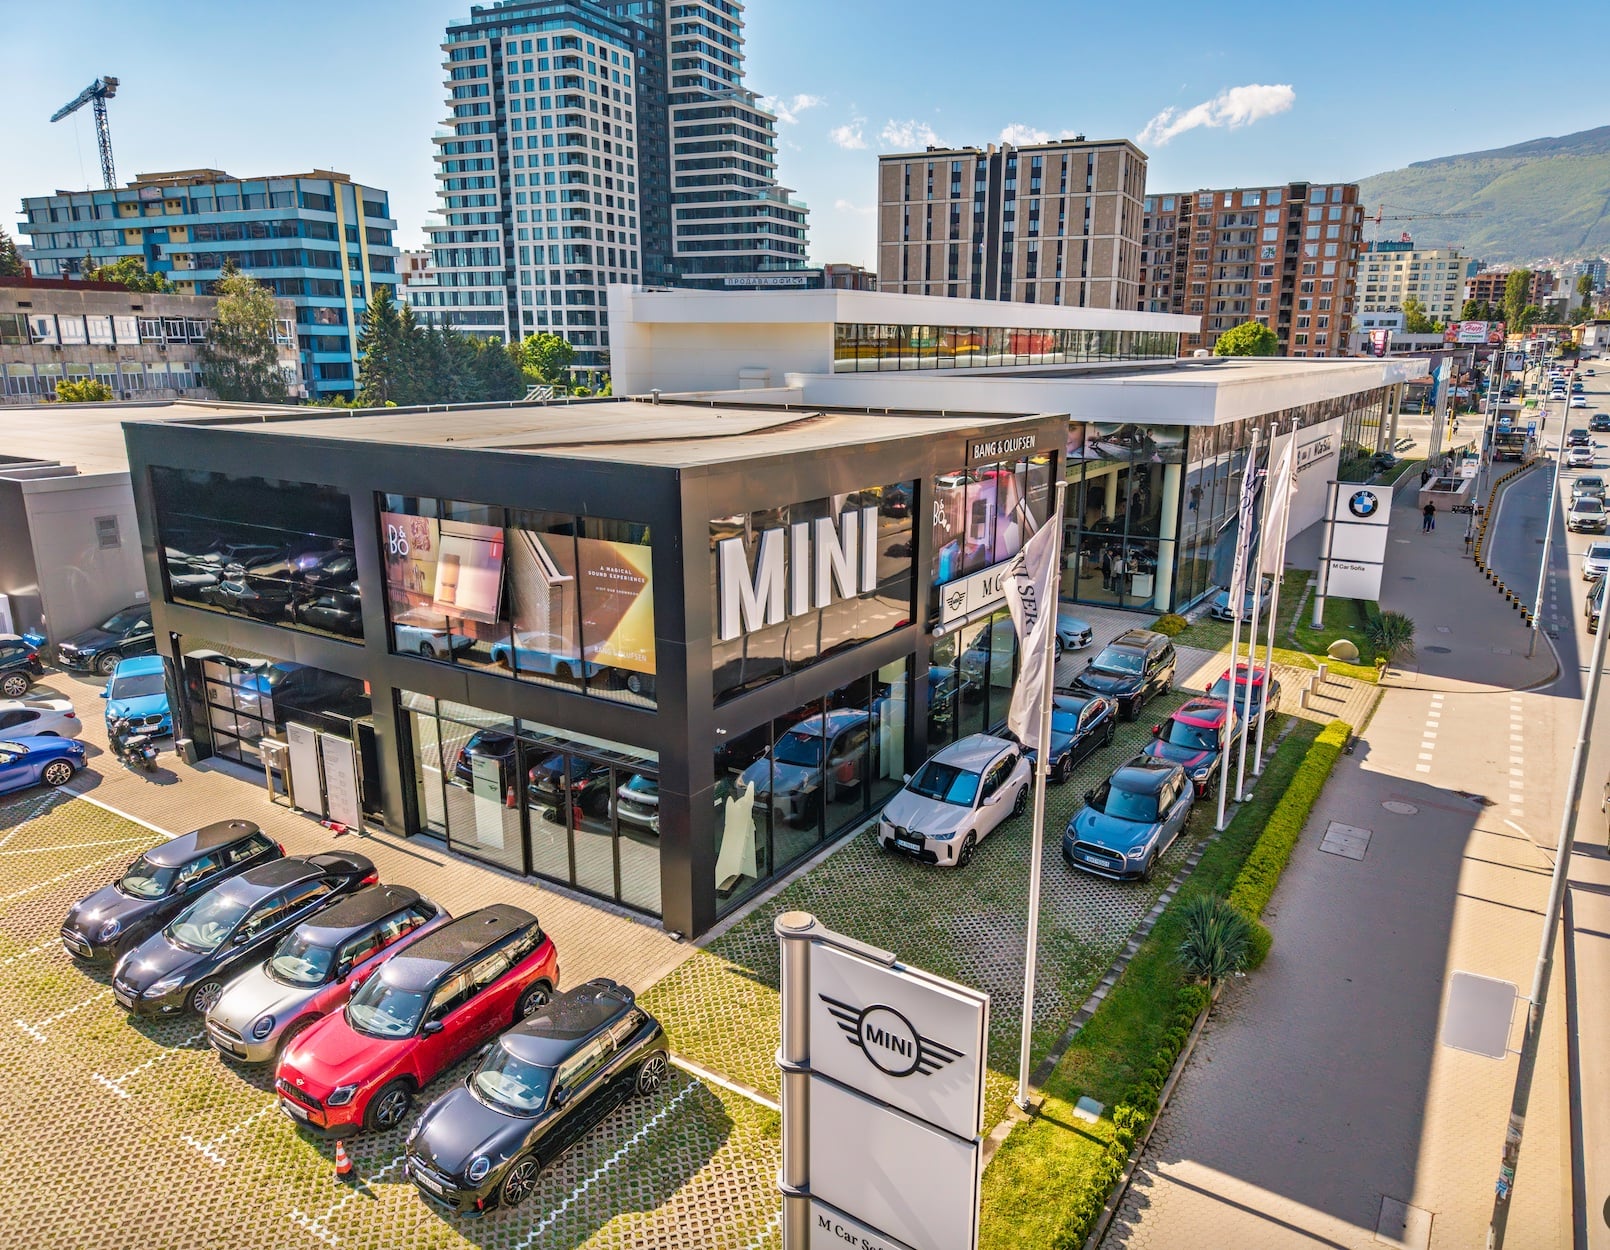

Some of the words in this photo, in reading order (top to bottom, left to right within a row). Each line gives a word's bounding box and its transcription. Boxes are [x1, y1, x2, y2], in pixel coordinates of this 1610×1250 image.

[974, 441, 996, 458] BANG
[997, 440, 1003, 454] &
[1003, 435, 1036, 453] OLUFSEN
[588, 570, 607, 578] SOUND
[609, 573, 645, 583] EXPERIENCE
[606, 566, 632, 575] MAGICAL
[719, 506, 878, 641] MINI
[982, 578, 993, 598] M
[866, 1023, 912, 1058] MINI
[818, 1214, 831, 1232] M
[835, 1225, 858, 1245] Car
